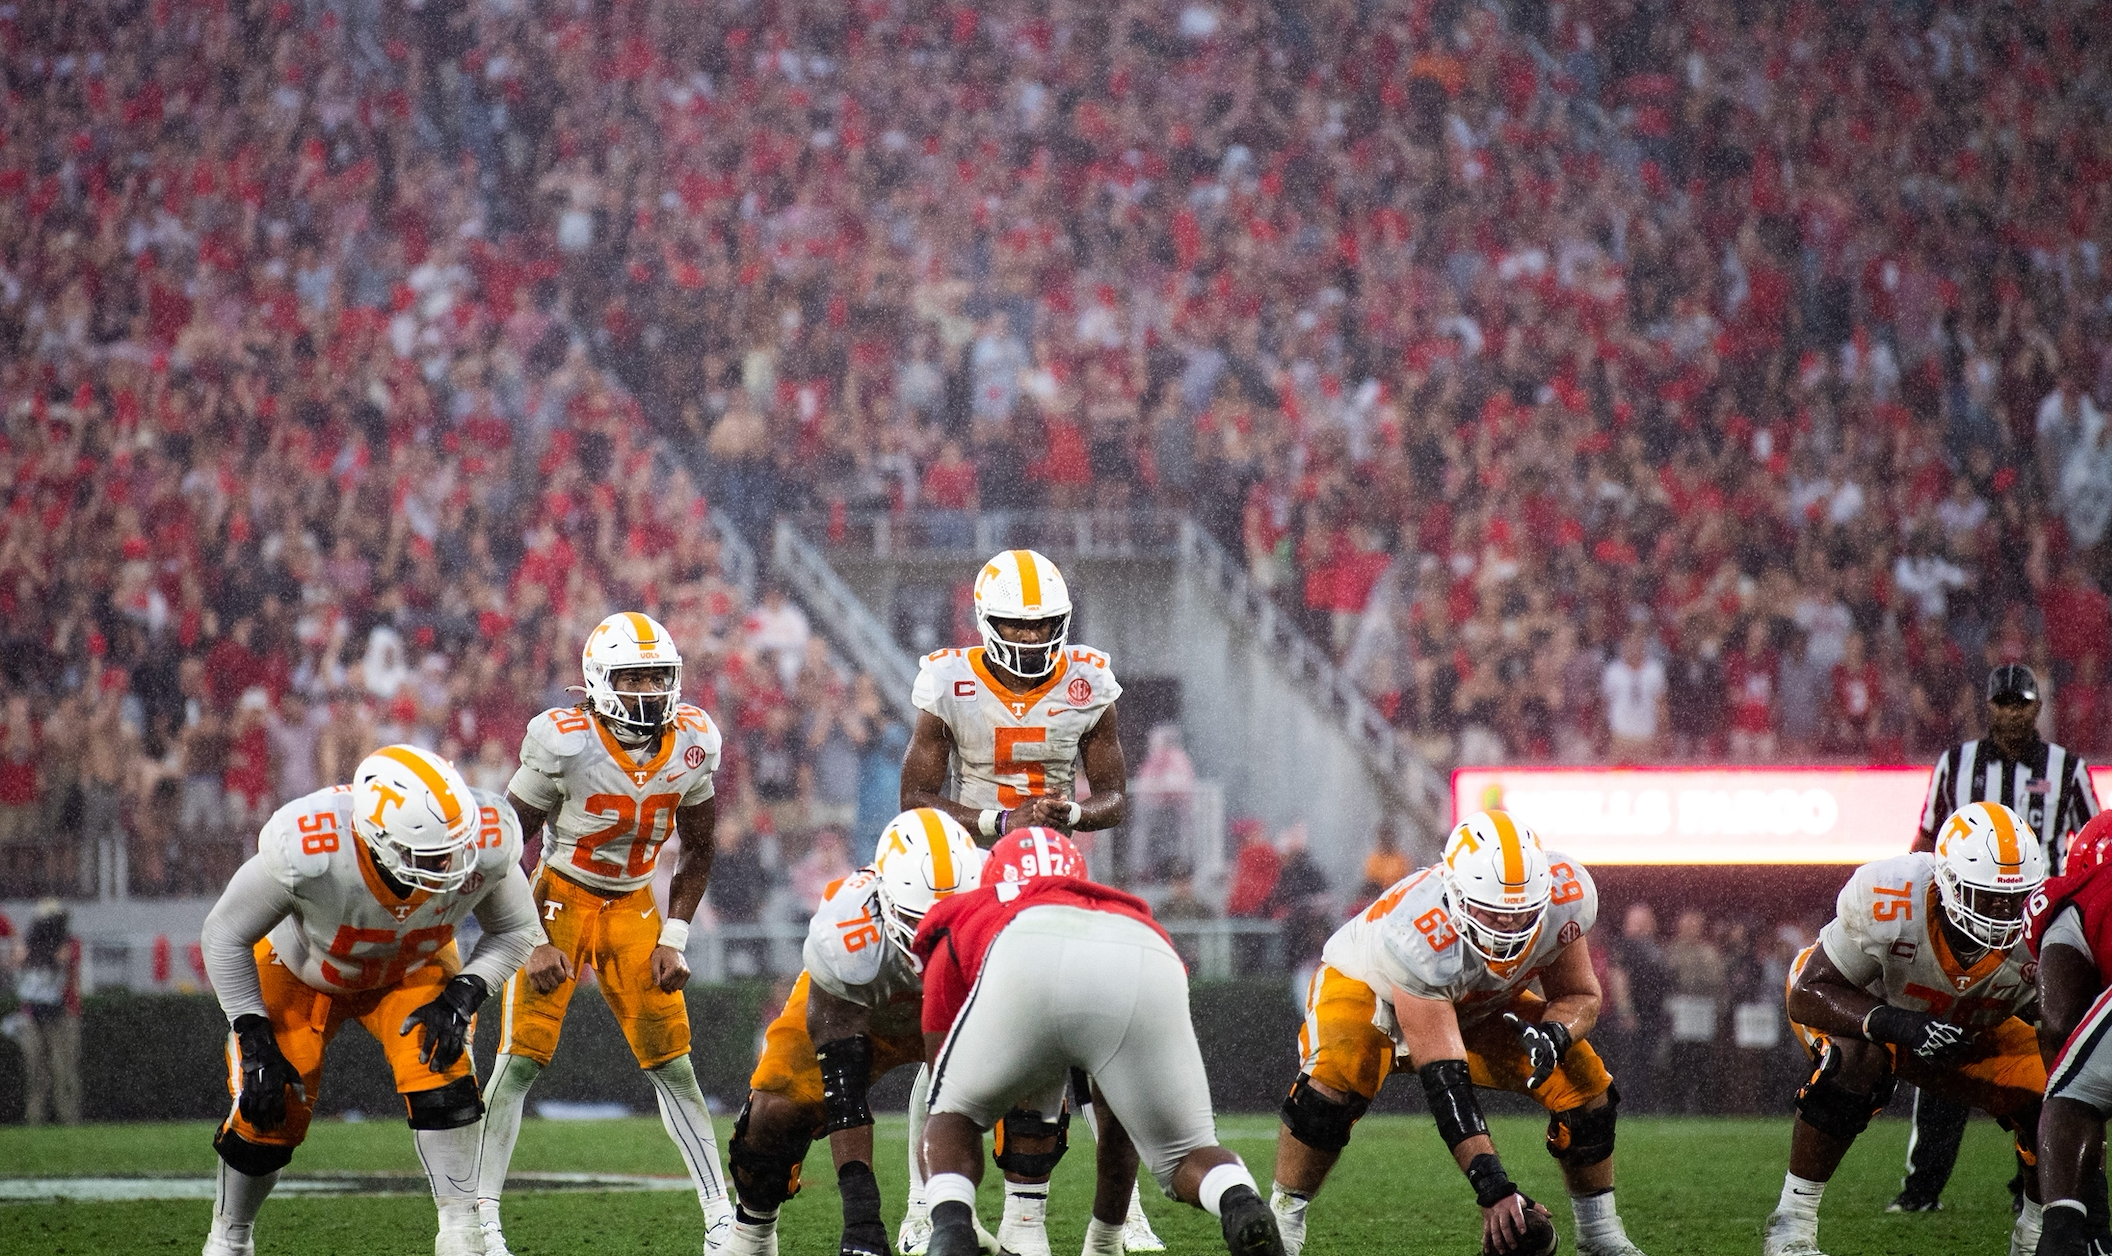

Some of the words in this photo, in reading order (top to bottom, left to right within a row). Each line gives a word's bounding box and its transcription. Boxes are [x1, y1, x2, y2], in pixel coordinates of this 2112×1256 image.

[1073, 650, 1105, 669] 5
[954, 681, 976, 697] C
[1069, 679, 1091, 701] SEC
[549, 707, 590, 734] 20
[1012, 702, 1026, 717] T
[685, 747, 706, 769] SEC
[993, 727, 1047, 809] 5
[634, 771, 647, 785] T
[369, 780, 406, 829] T
[2029, 809, 2044, 829] C
[297, 812, 340, 856] 58
[570, 792, 682, 878] 20
[1938, 814, 1973, 858] T
[877, 829, 907, 874] T
[1447, 826, 1480, 872] T
[1021, 853, 1064, 877] 97
[1549, 862, 1585, 906] 63
[1997, 876, 2024, 884] Riddell
[543, 899, 563, 921] T
[1504, 896, 1526, 904] VOLS
[1872, 881, 1913, 922] 75
[395, 905, 410, 919] T
[835, 905, 880, 953] 76
[1413, 907, 1459, 952] 63
[1558, 921, 1581, 944] SEC
[320, 923, 455, 990] 58
[1890, 941, 1916, 959] C
[1506, 965, 1518, 979] T
[1956, 976, 1971, 990] T
